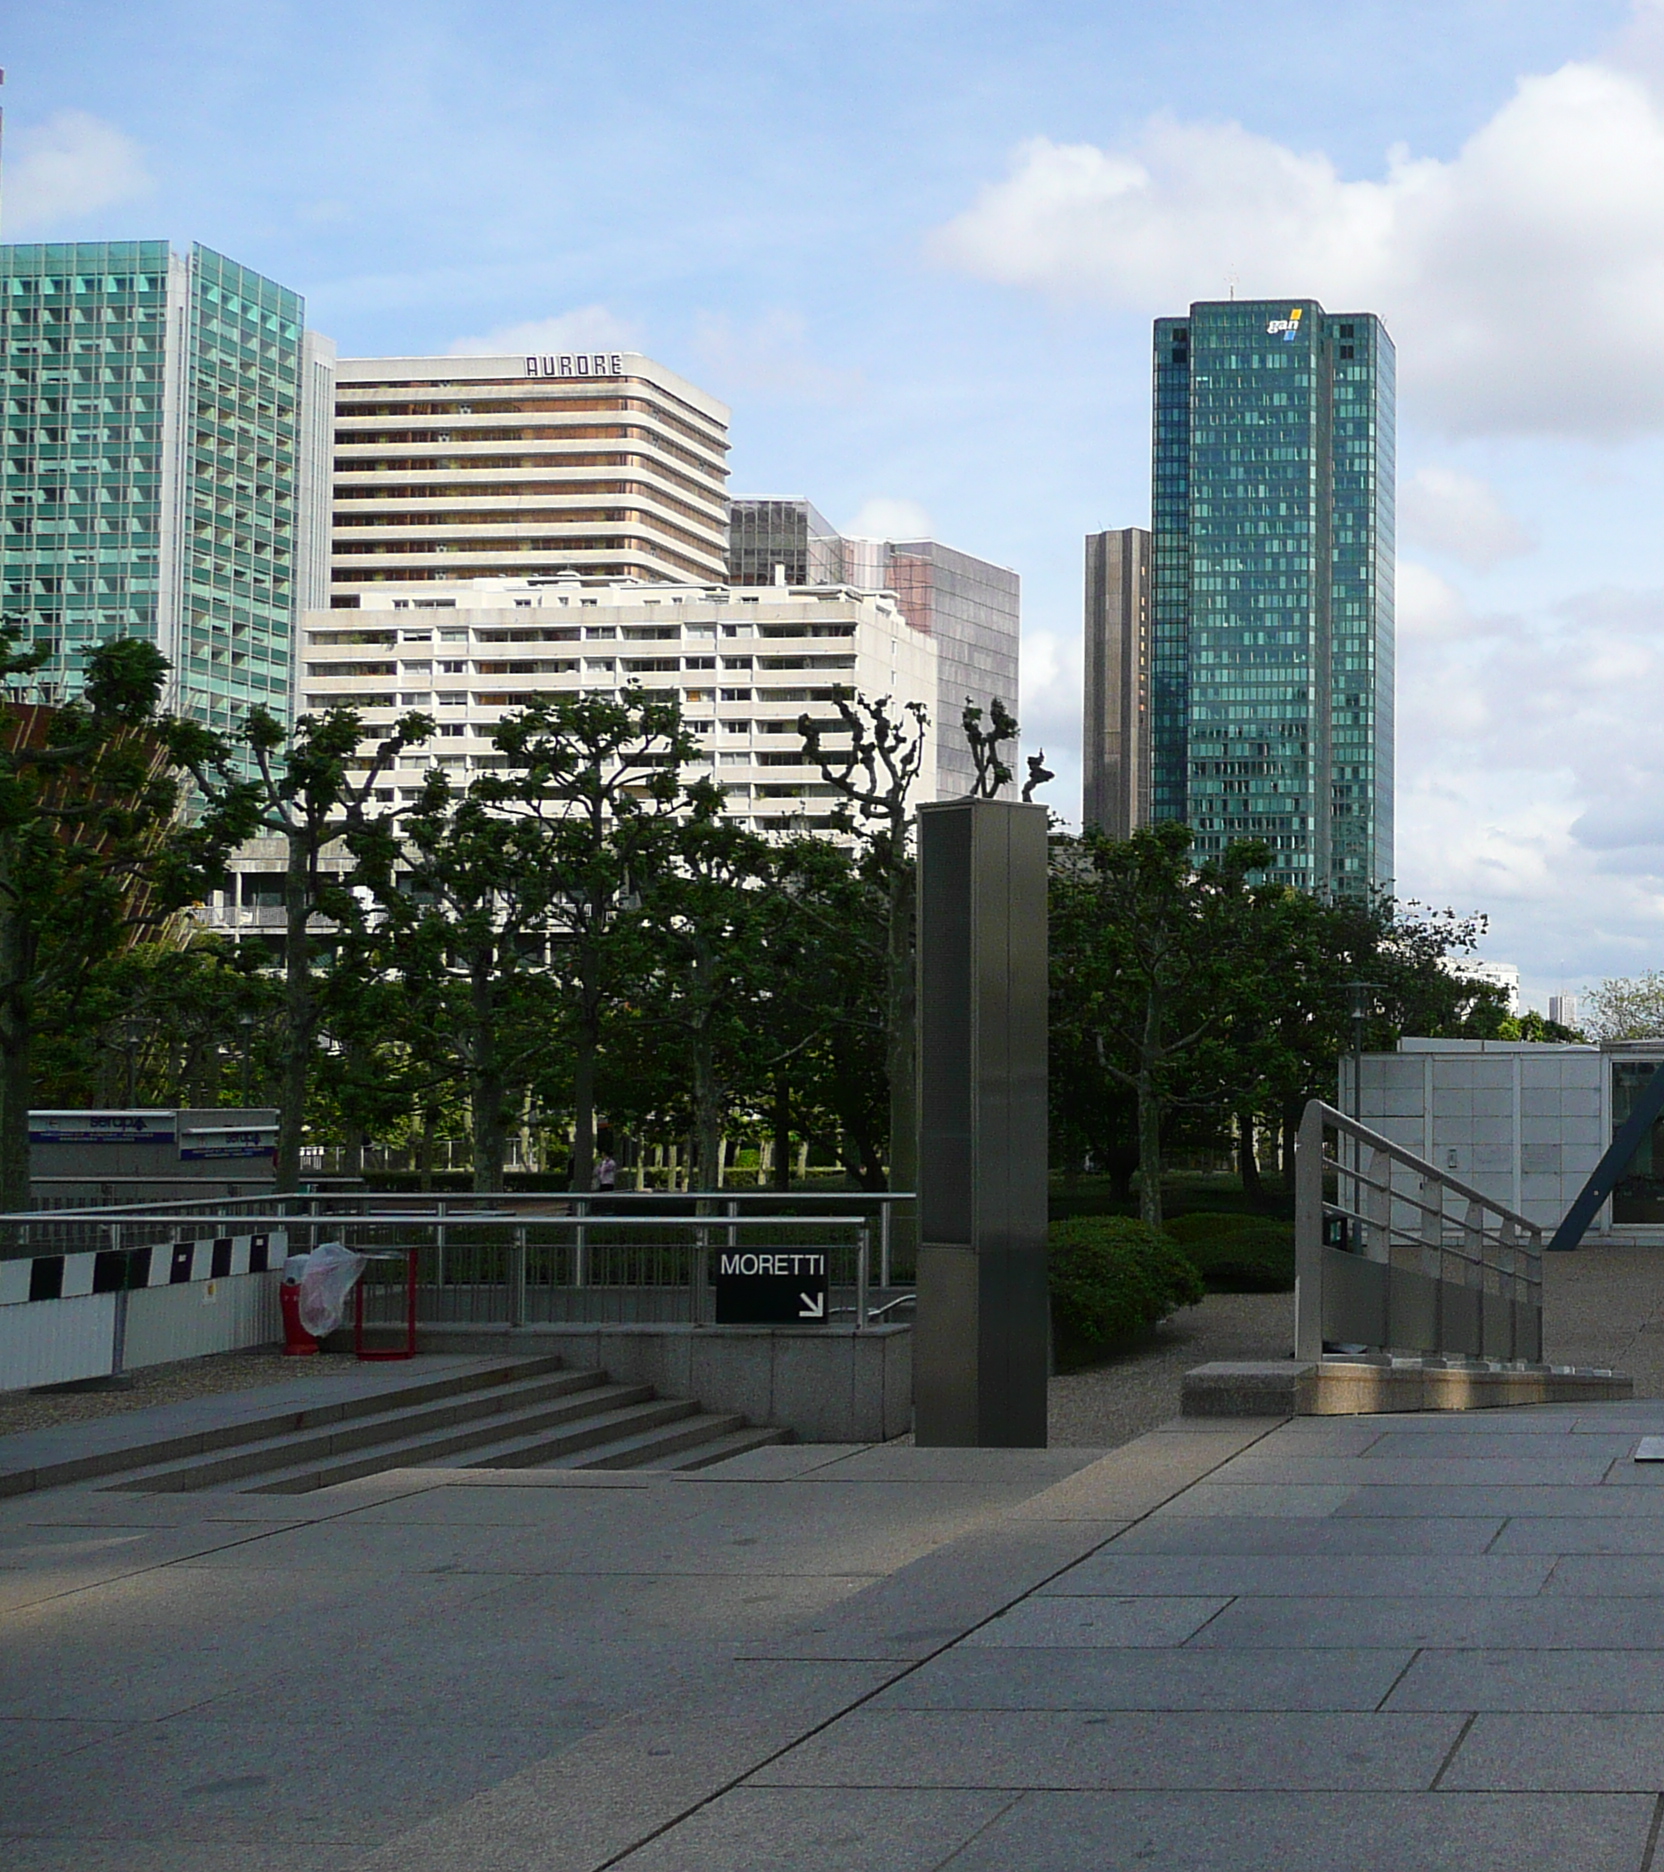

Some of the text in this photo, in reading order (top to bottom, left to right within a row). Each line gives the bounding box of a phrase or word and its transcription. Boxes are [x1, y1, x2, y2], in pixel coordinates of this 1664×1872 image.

[1267, 320, 1299, 334] gan
[527, 355, 622, 376] AURORE
[721, 1254, 824, 1275] MORETTI
